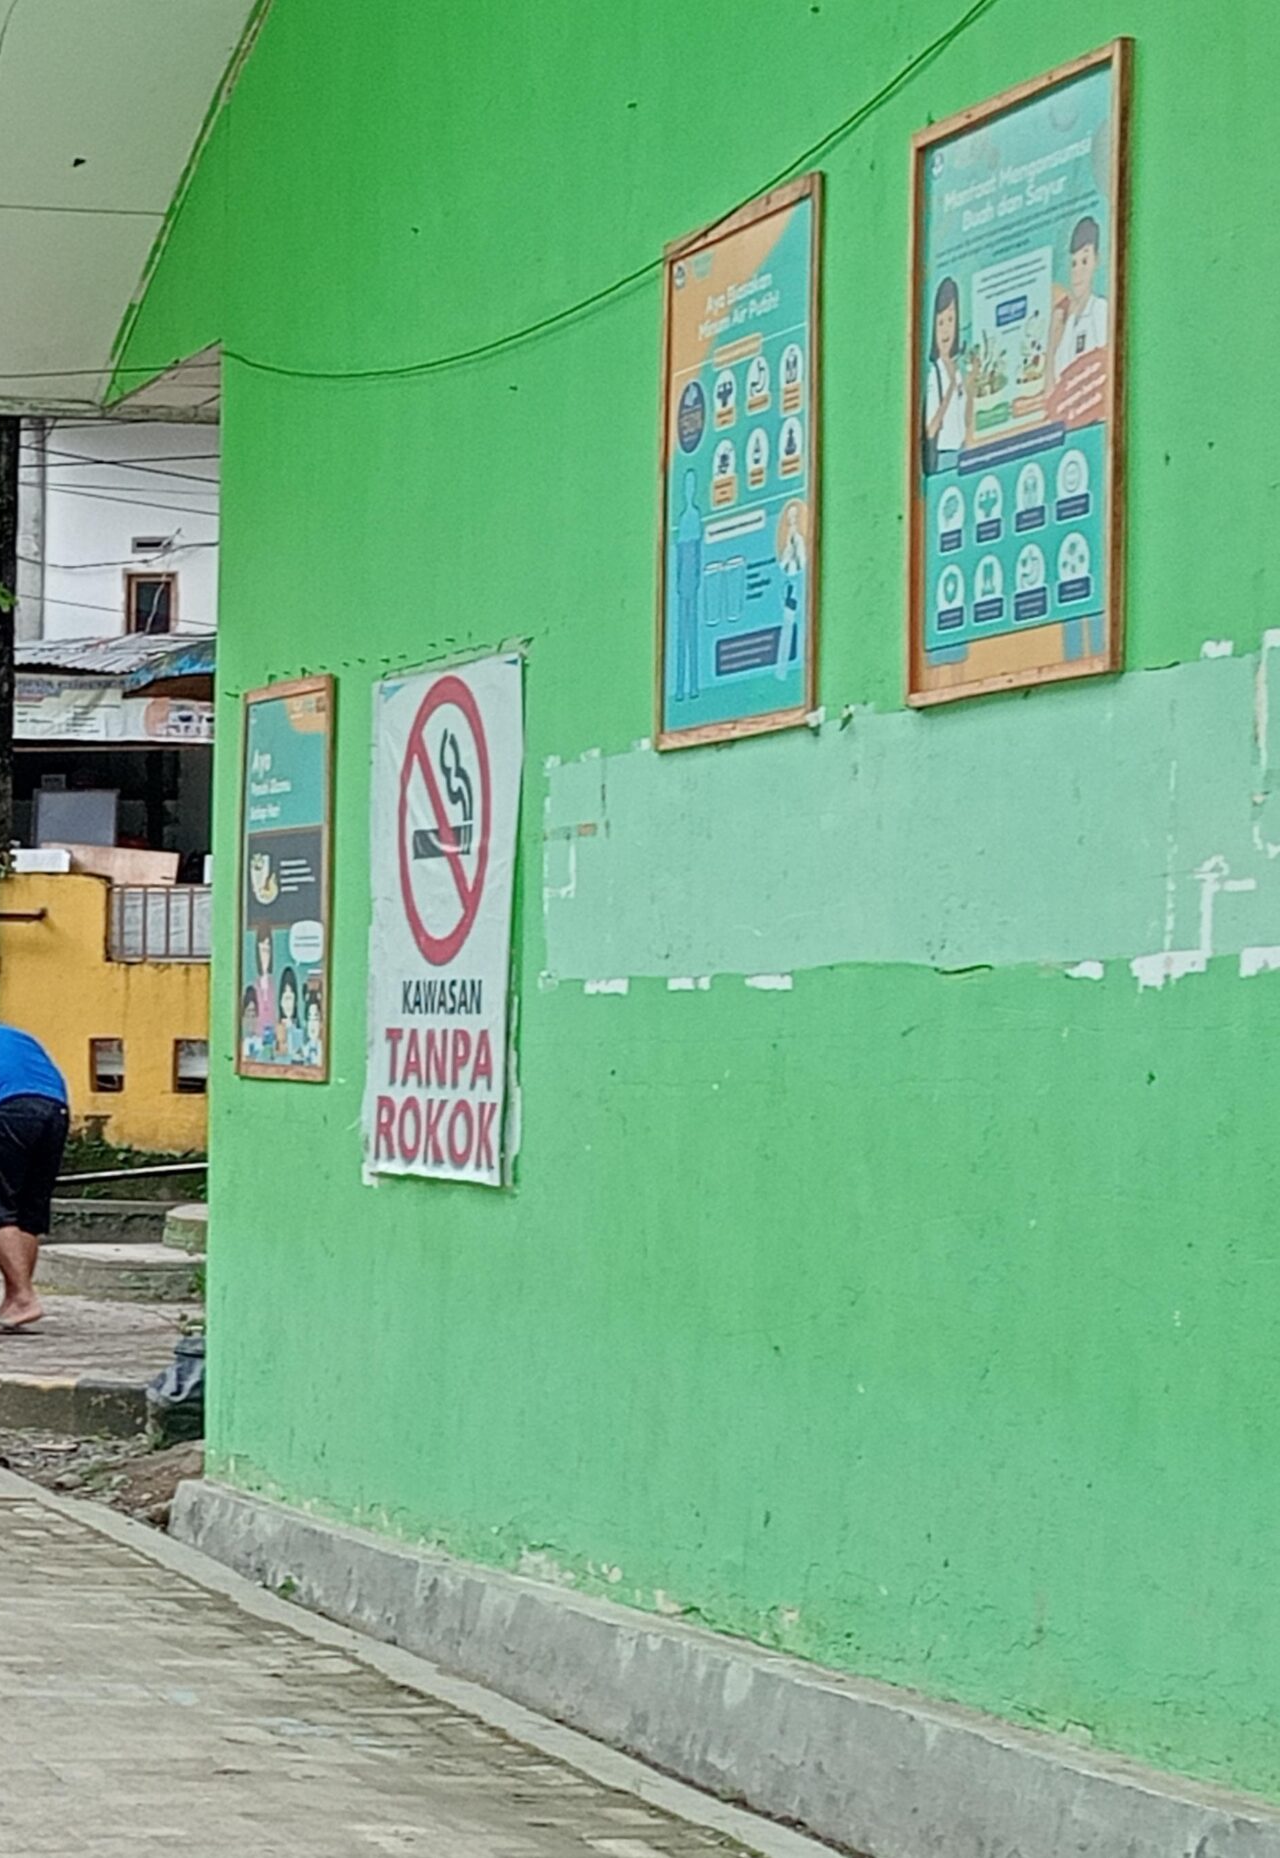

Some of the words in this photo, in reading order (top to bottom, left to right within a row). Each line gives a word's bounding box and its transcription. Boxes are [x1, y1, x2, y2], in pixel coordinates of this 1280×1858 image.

[401, 979, 483, 1015] KAWASAN
[385, 1027, 493, 1092] TANPA
[373, 1095, 498, 1171] ROKOK
